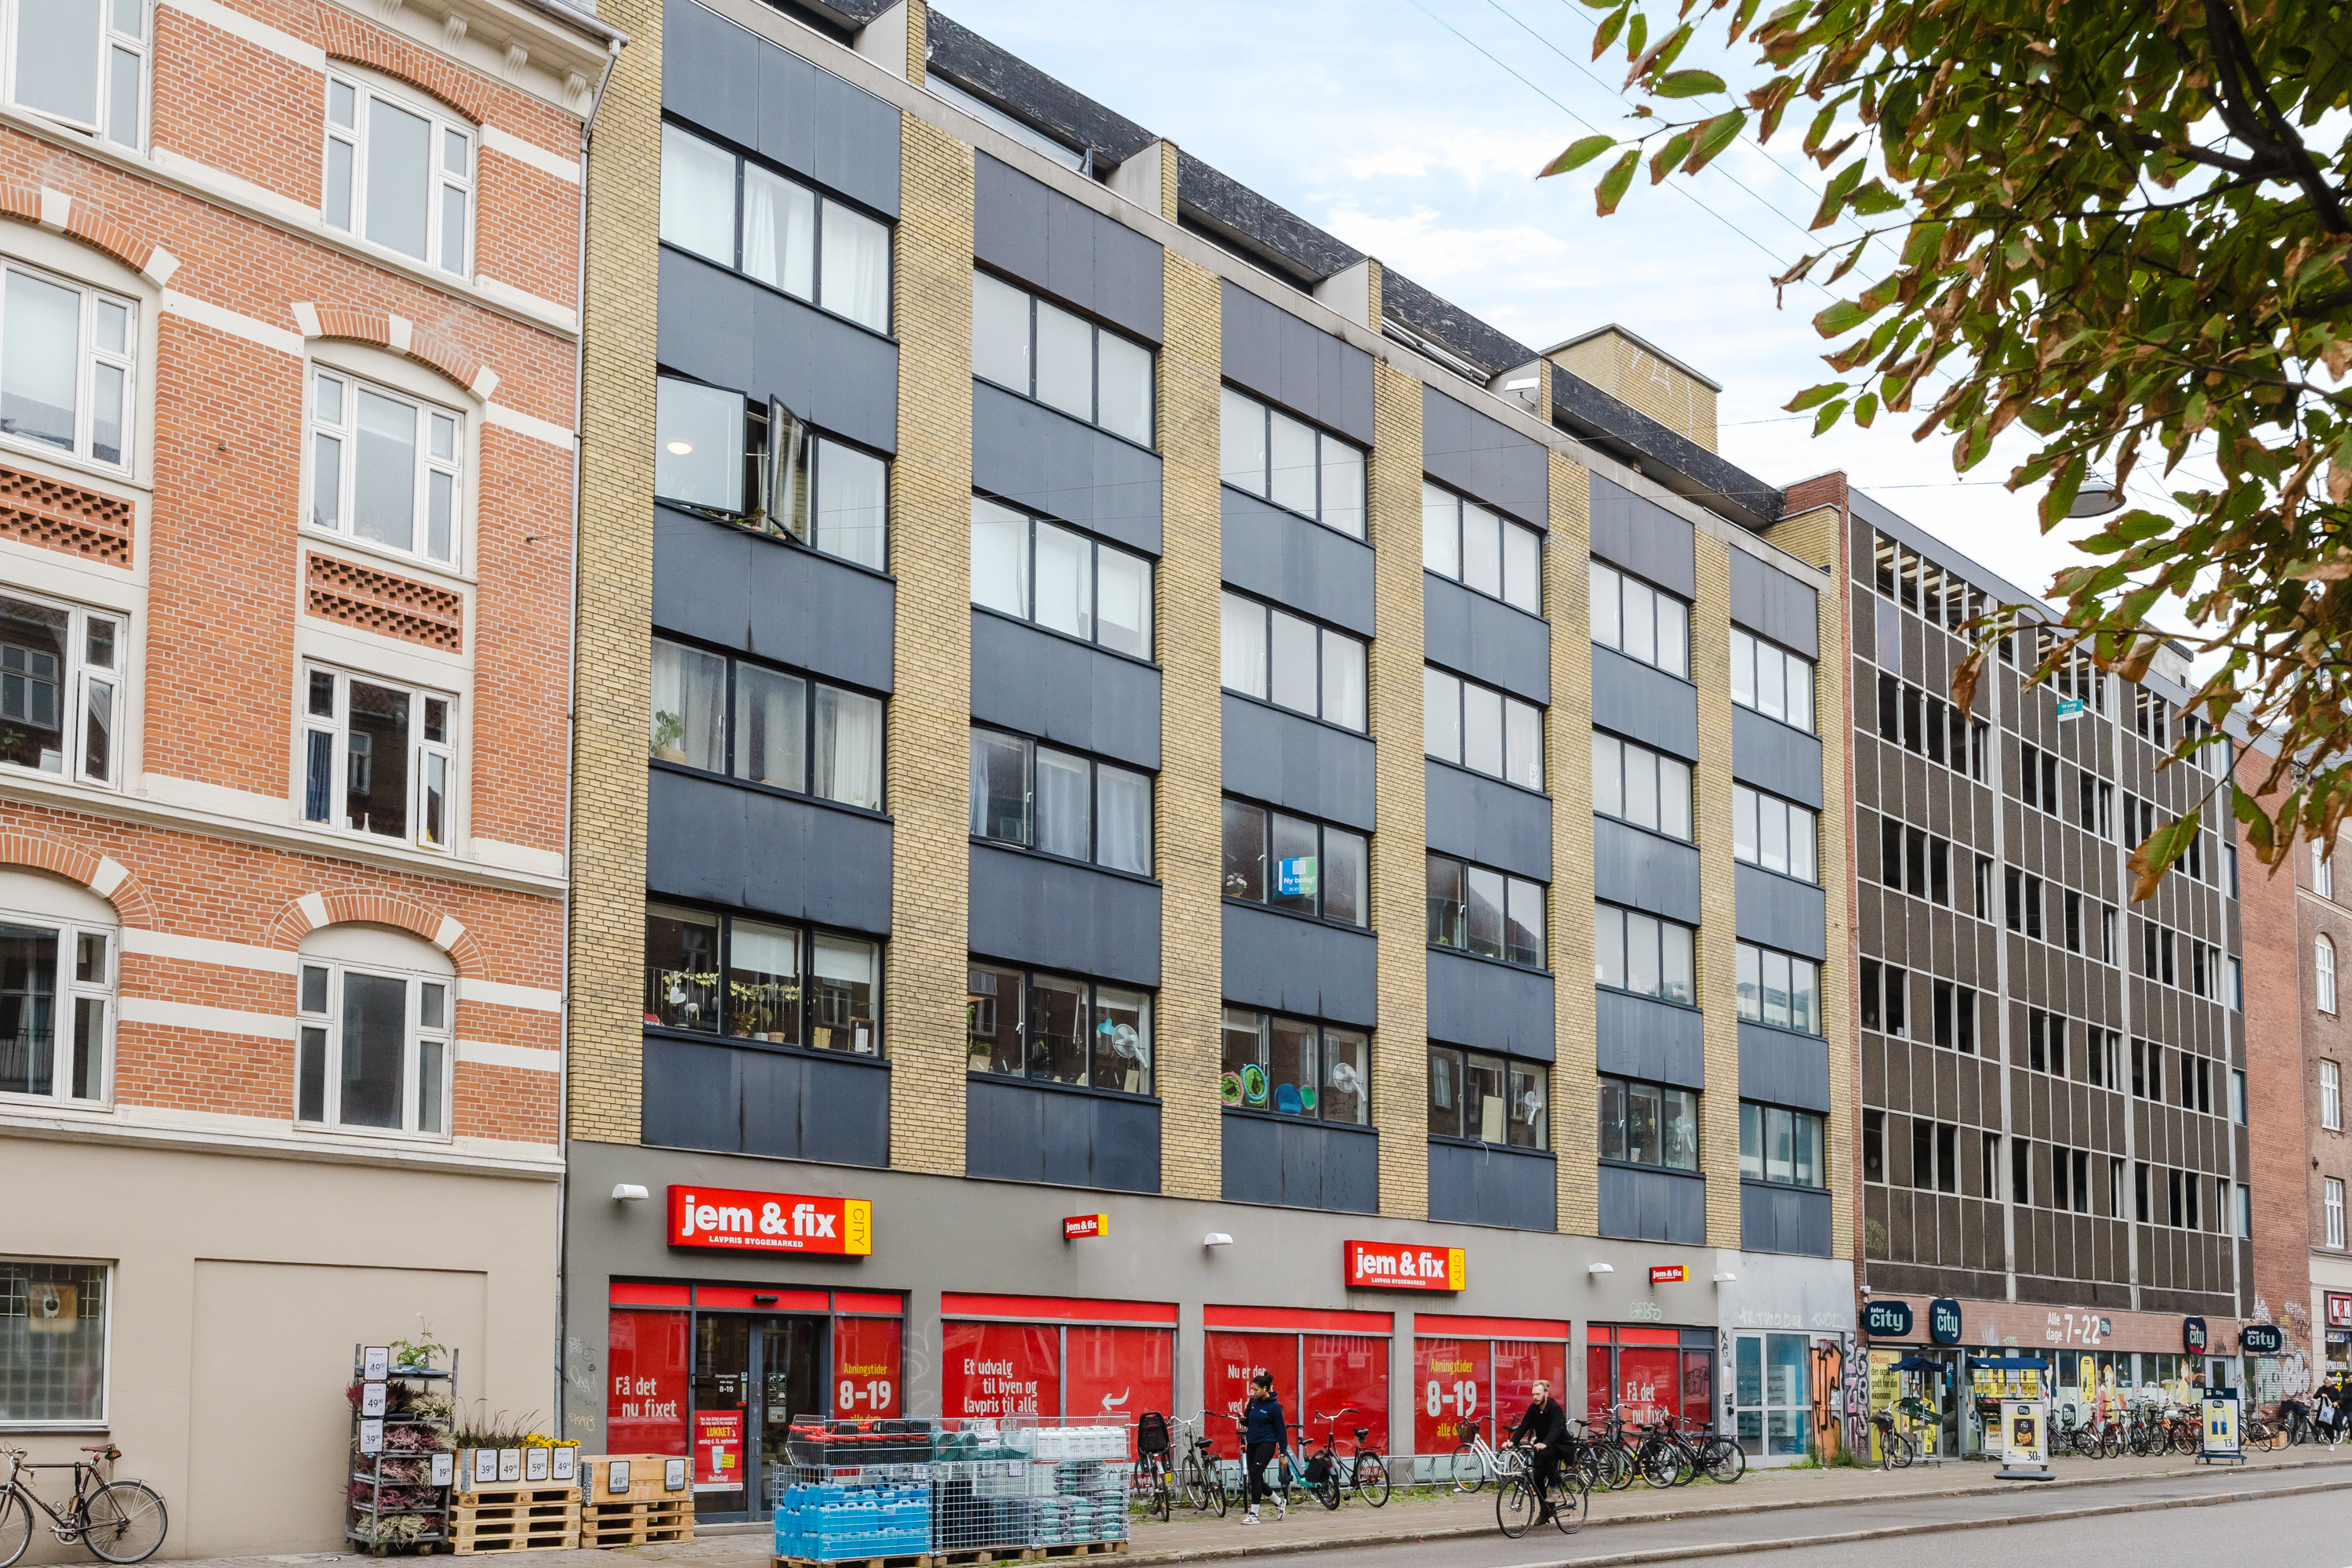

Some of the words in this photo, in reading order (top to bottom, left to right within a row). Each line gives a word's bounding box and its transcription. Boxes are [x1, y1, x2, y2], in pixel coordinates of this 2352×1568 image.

[682, 1195, 753, 1236] jem
[760, 1202, 788, 1235] &
[792, 1203, 837, 1238] fix
[852, 1208, 865, 1247] CITY
[1066, 1222, 1080, 1233] jem
[1081, 1221, 1087, 1229] &
[1087, 1220, 1097, 1229] fix
[709, 1236, 742, 1244] LAVPRIS
[745, 1237, 804, 1247] BYGGEMARKED
[1356, 1247, 1396, 1279] jem
[1399, 1251, 1417, 1276] &
[1418, 1252, 1445, 1278] fix
[1653, 1270, 1666, 1279] jem
[1871, 1309, 1904, 1331] city
[1937, 1310, 1958, 1338] city
[2047, 1312, 2060, 1326] Alle
[2046, 1327, 2063, 1344] dage
[2064, 1313, 2100, 1345] 7-22
[2190, 1327, 2205, 1348] city
[2247, 1332, 2275, 1348] city
[964, 1359, 975, 1375] Et
[978, 1359, 1013, 1378] udvalg
[1431, 1358, 1473, 1375] Åbningstider
[1871, 1354, 1889, 1366] Økologi
[844, 1363, 887, 1377] Åbningstider
[1228, 1364, 1240, 1379] Nu
[1242, 1367, 1250, 1379] er
[615, 1375, 630, 1396] Få
[636, 1377, 657, 1396] det
[983, 1378, 996, 1394] til
[999, 1378, 1023, 1397] byen
[1025, 1381, 1037, 1396] og
[1627, 1381, 1638, 1401] Få
[1640, 1382, 1655, 1402] det
[1871, 1379, 1882, 1389] godt
[840, 1380, 891, 1410] 8-19
[1427, 1380, 1477, 1417] 8-19
[622, 1403, 638, 1417] nu
[644, 1399, 677, 1417] fixet
[964, 1396, 999, 1417] lavpris
[1002, 1397, 1015, 1413] til
[1018, 1398, 1037, 1414] alle
[1228, 1398, 1243, 1412] ved
[1632, 1409, 1644, 1425] nu
[1647, 1405, 1669, 1425] fixet
[706, 1427, 731, 1437] LUKKET
[1437, 1423, 1450, 1436] alle
